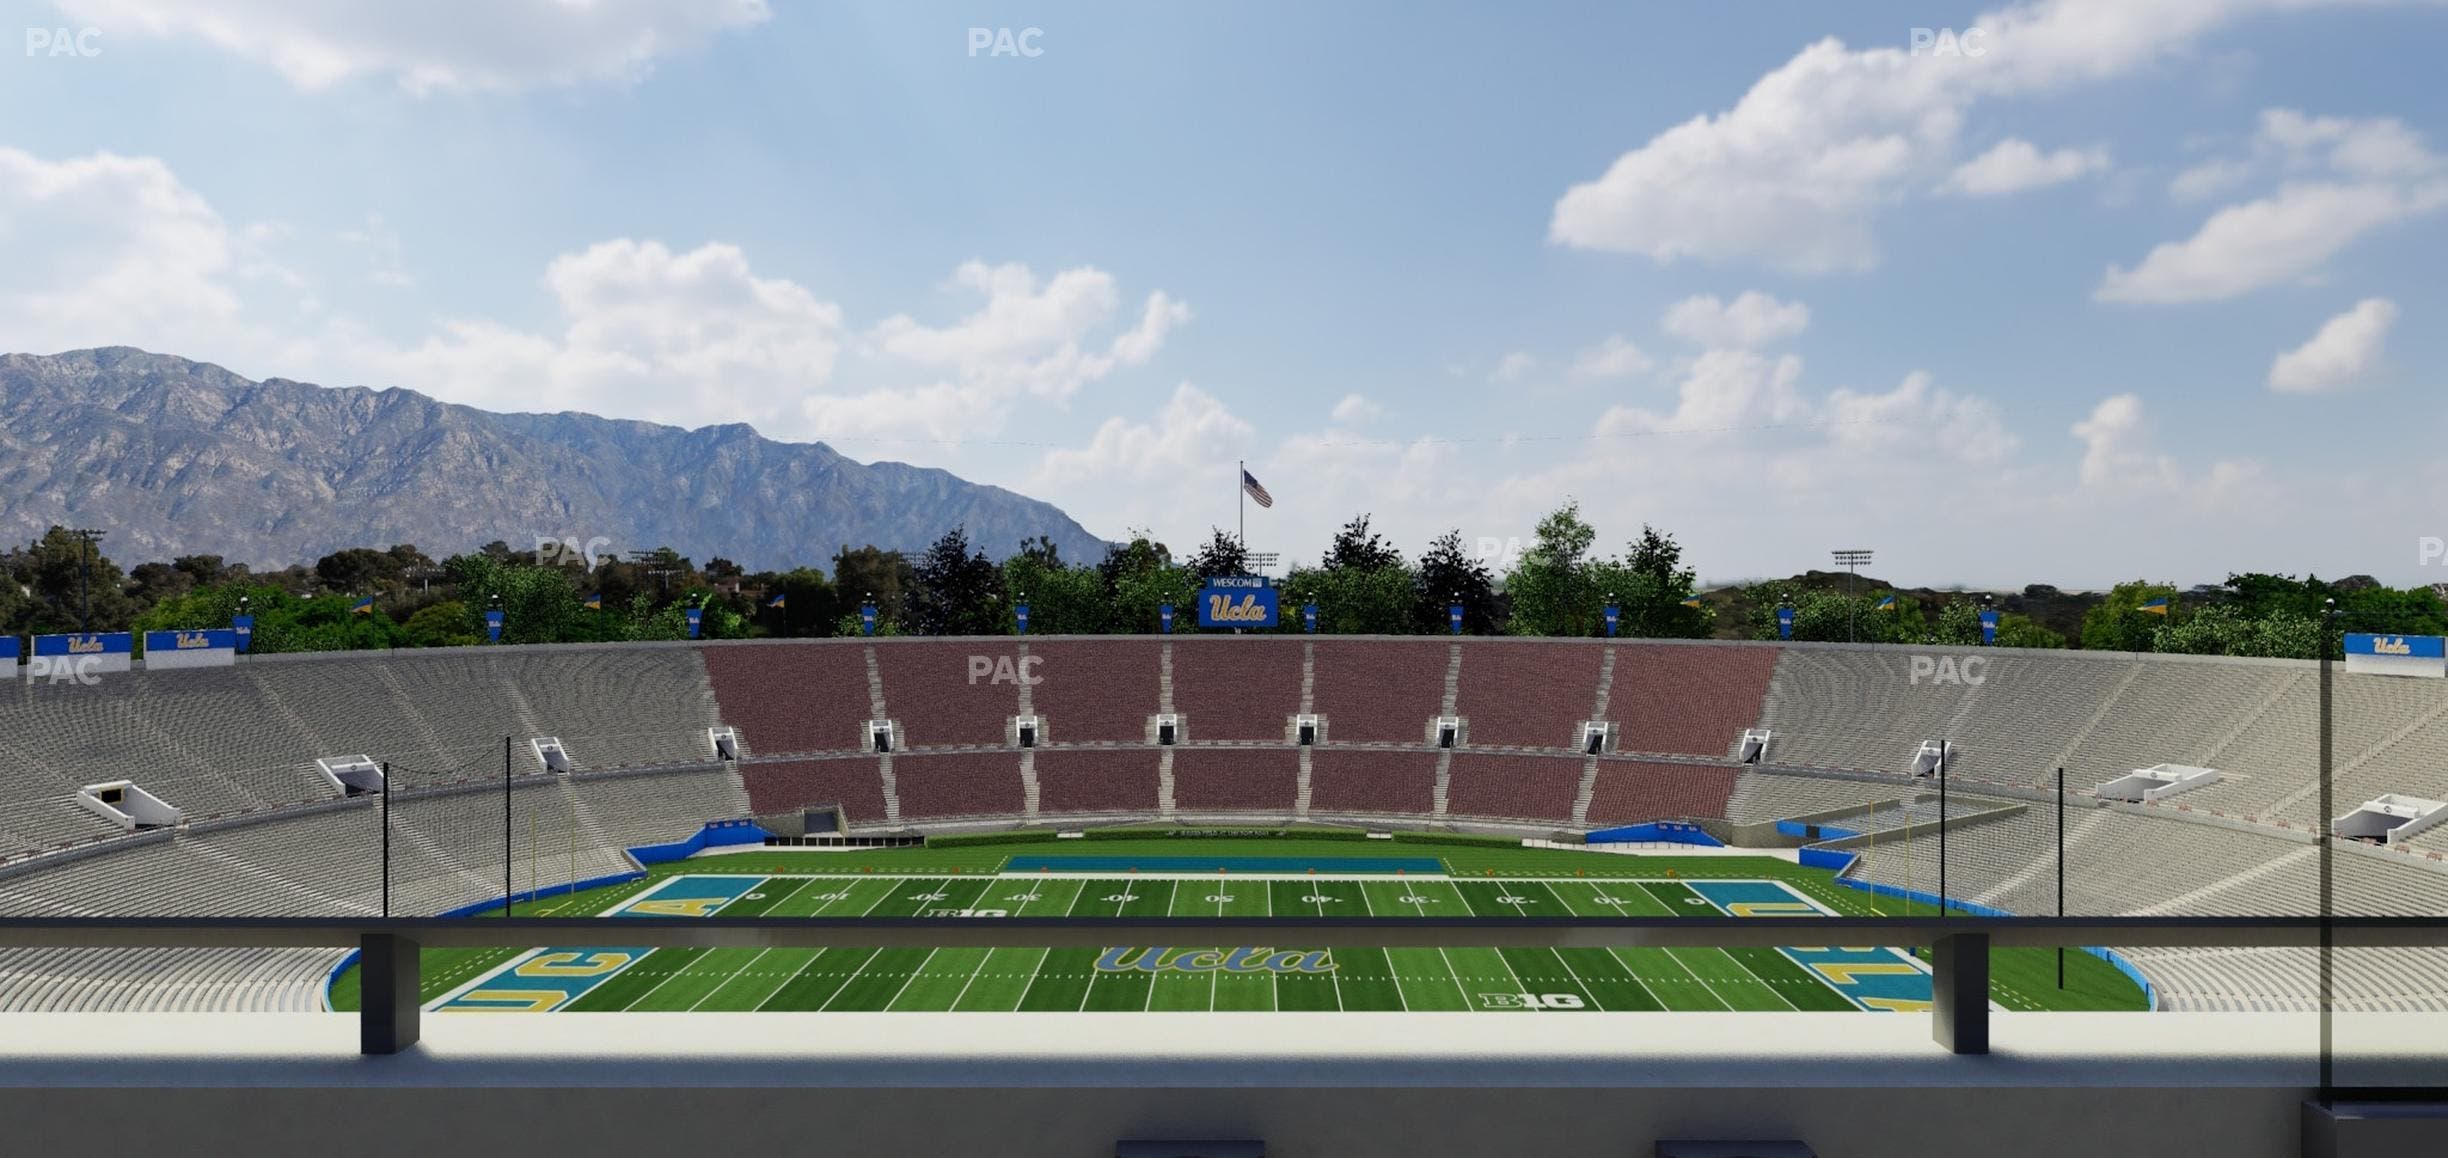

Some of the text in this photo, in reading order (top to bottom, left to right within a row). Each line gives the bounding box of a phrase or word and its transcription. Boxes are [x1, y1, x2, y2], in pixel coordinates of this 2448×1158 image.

[1213, 578, 1252, 588] WESCOM
[1209, 594, 1267, 621] Ucla
[1204, 894, 1235, 903] 50
